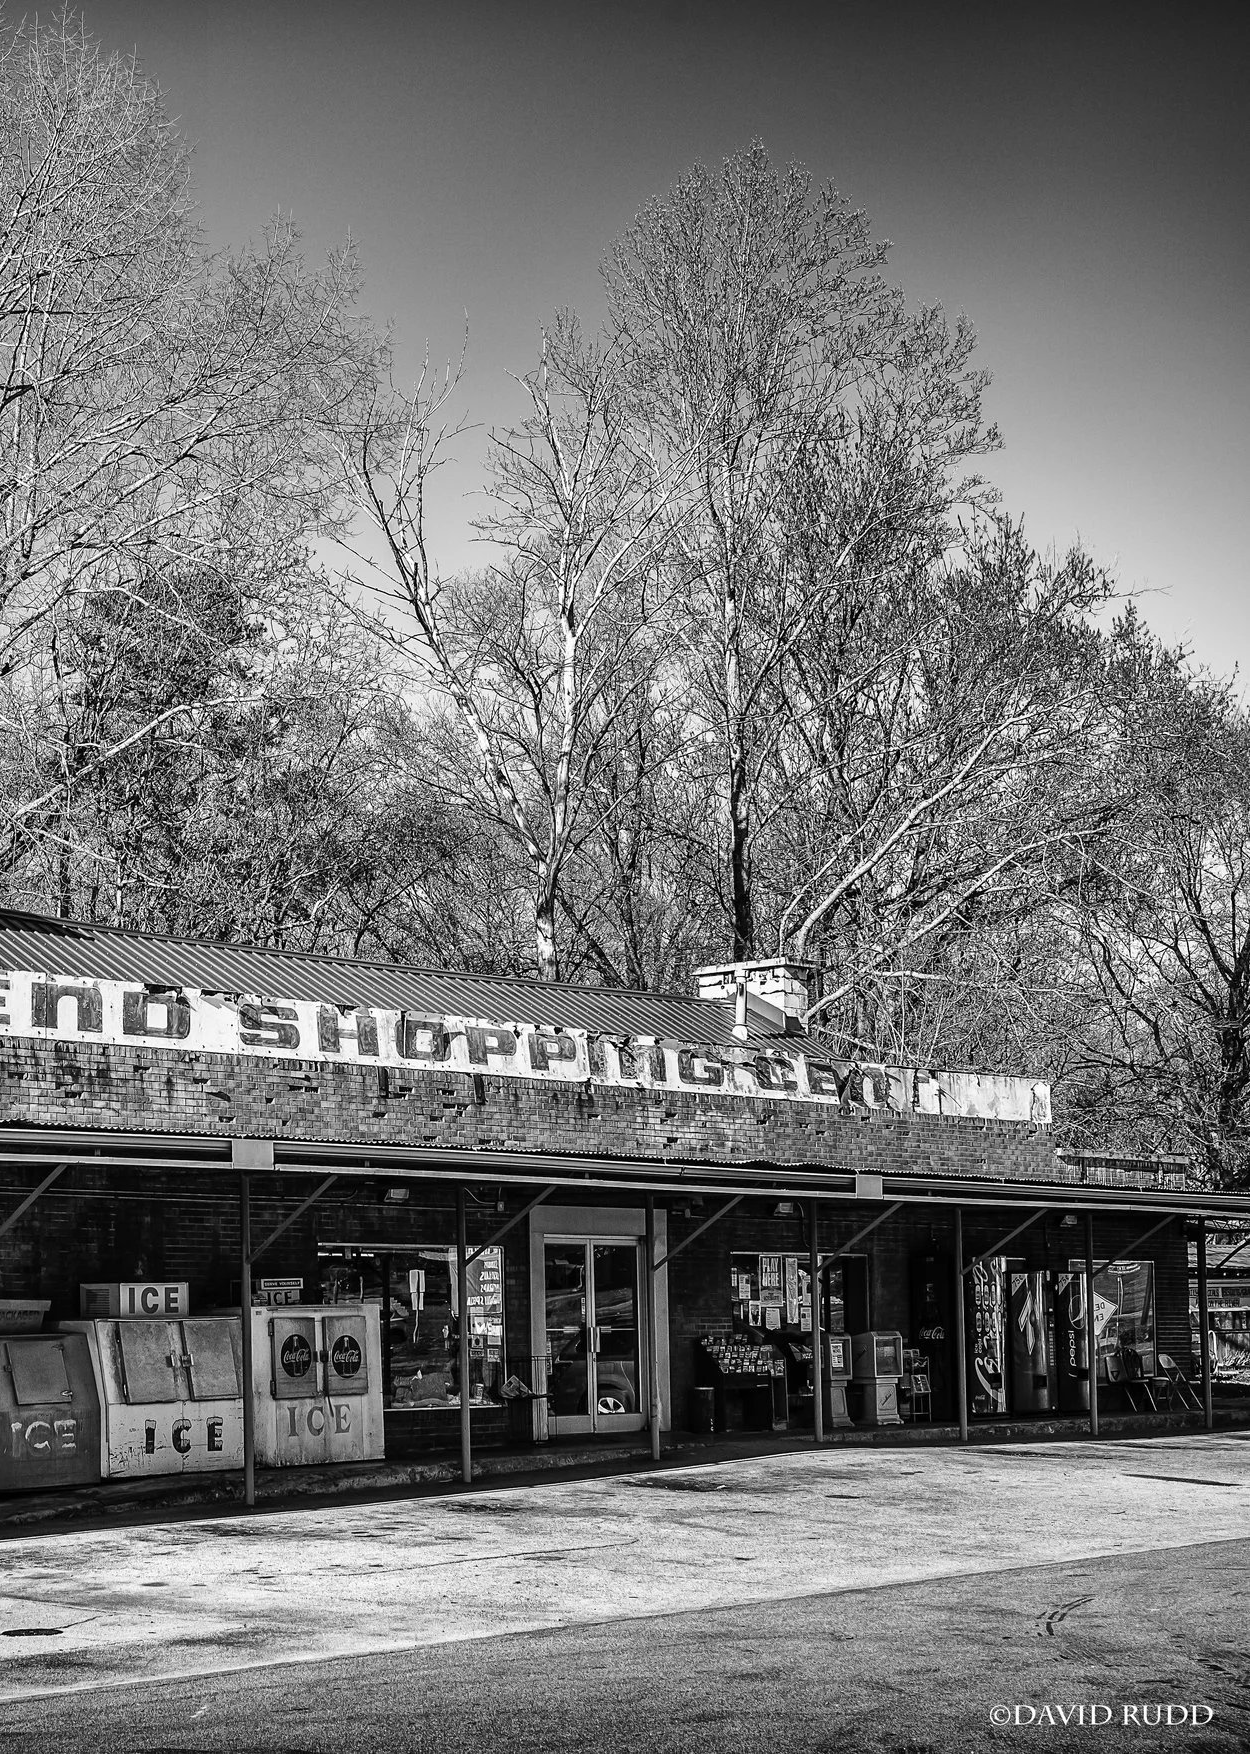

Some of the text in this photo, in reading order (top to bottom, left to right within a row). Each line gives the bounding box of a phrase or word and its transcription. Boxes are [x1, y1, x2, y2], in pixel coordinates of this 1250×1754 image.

[762, 1257, 779, 1272] PLAY
[762, 1272, 779, 1287] HERE
[128, 1286, 179, 1314] ICE
[144, 1416, 224, 1455] ICE
[288, 1403, 352, 1438] ICE
[10, 1419, 77, 1458] ICE
